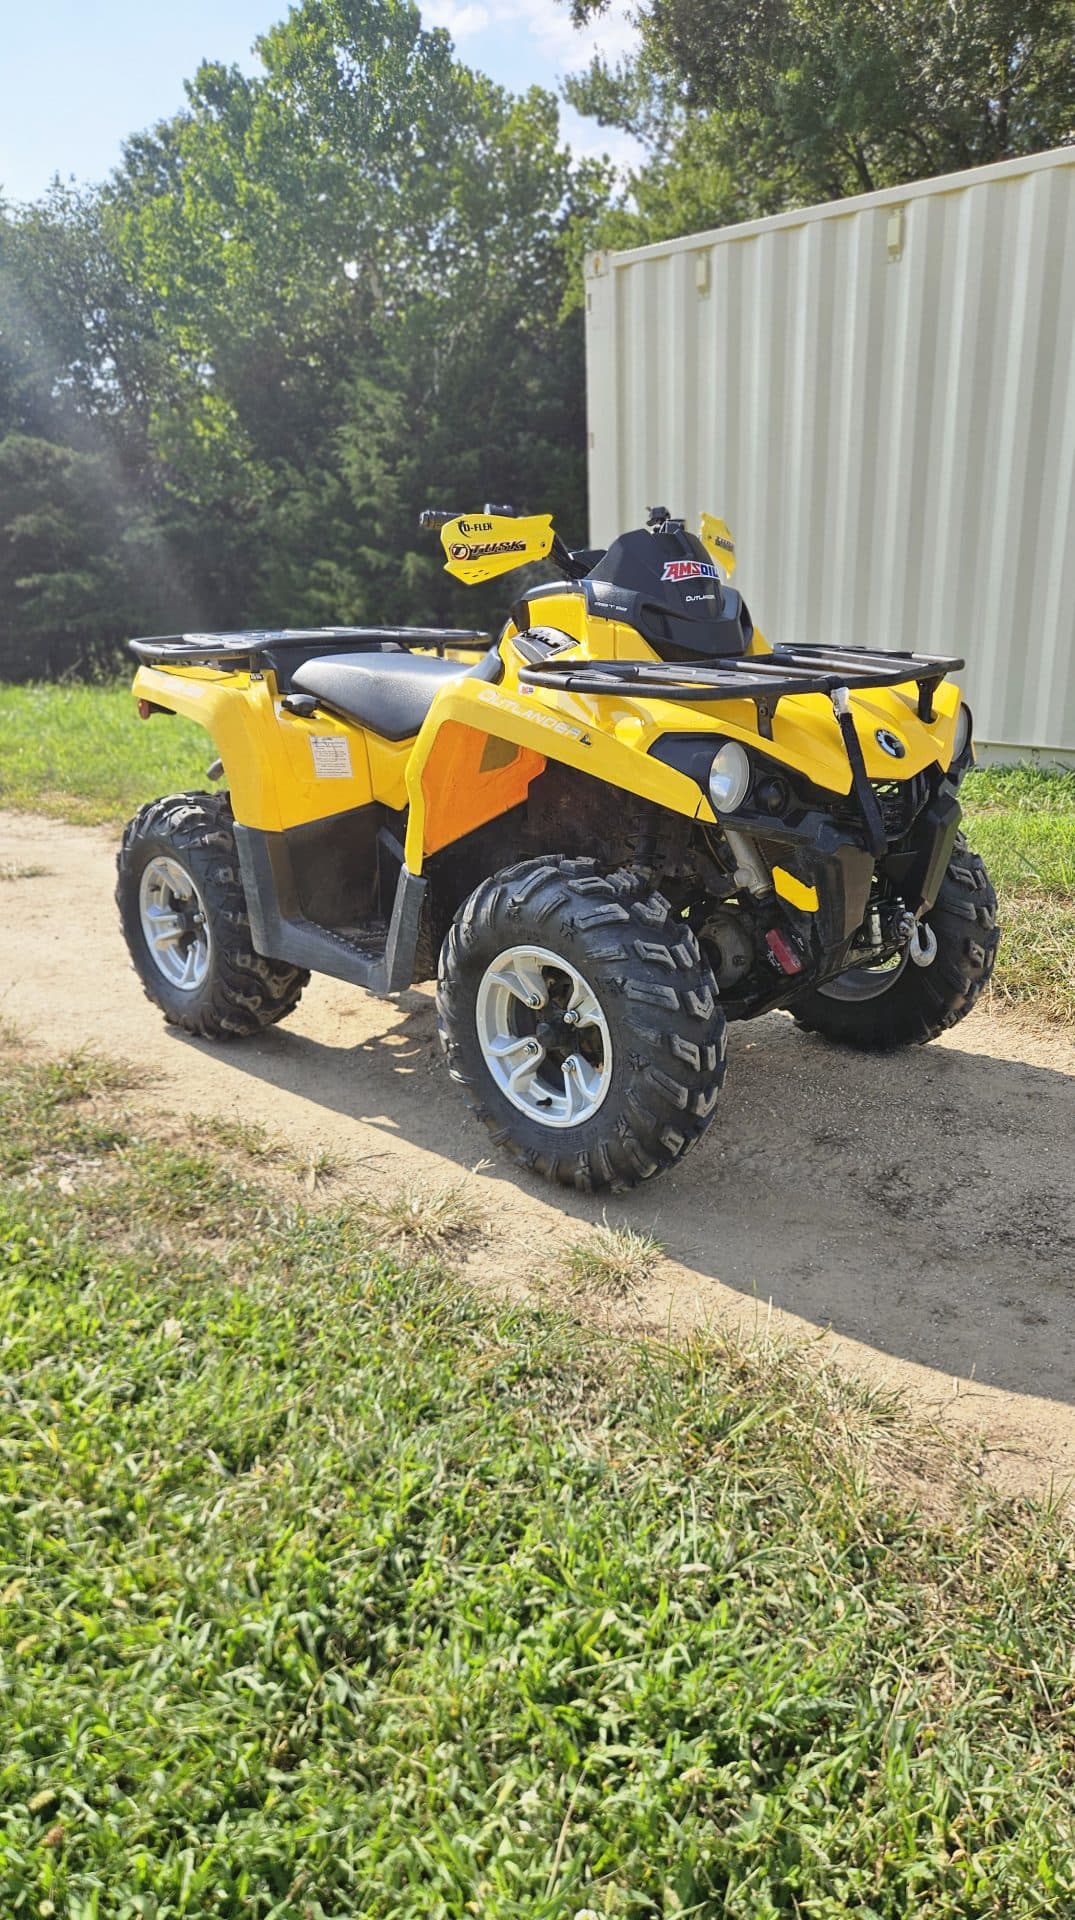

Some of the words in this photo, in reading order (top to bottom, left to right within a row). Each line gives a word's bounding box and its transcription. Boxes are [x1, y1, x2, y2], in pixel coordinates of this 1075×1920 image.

[470, 540, 526, 558] TUSK
[662, 561, 720, 582] AMSOIL
[477, 687, 582, 741] OUTLANDER
